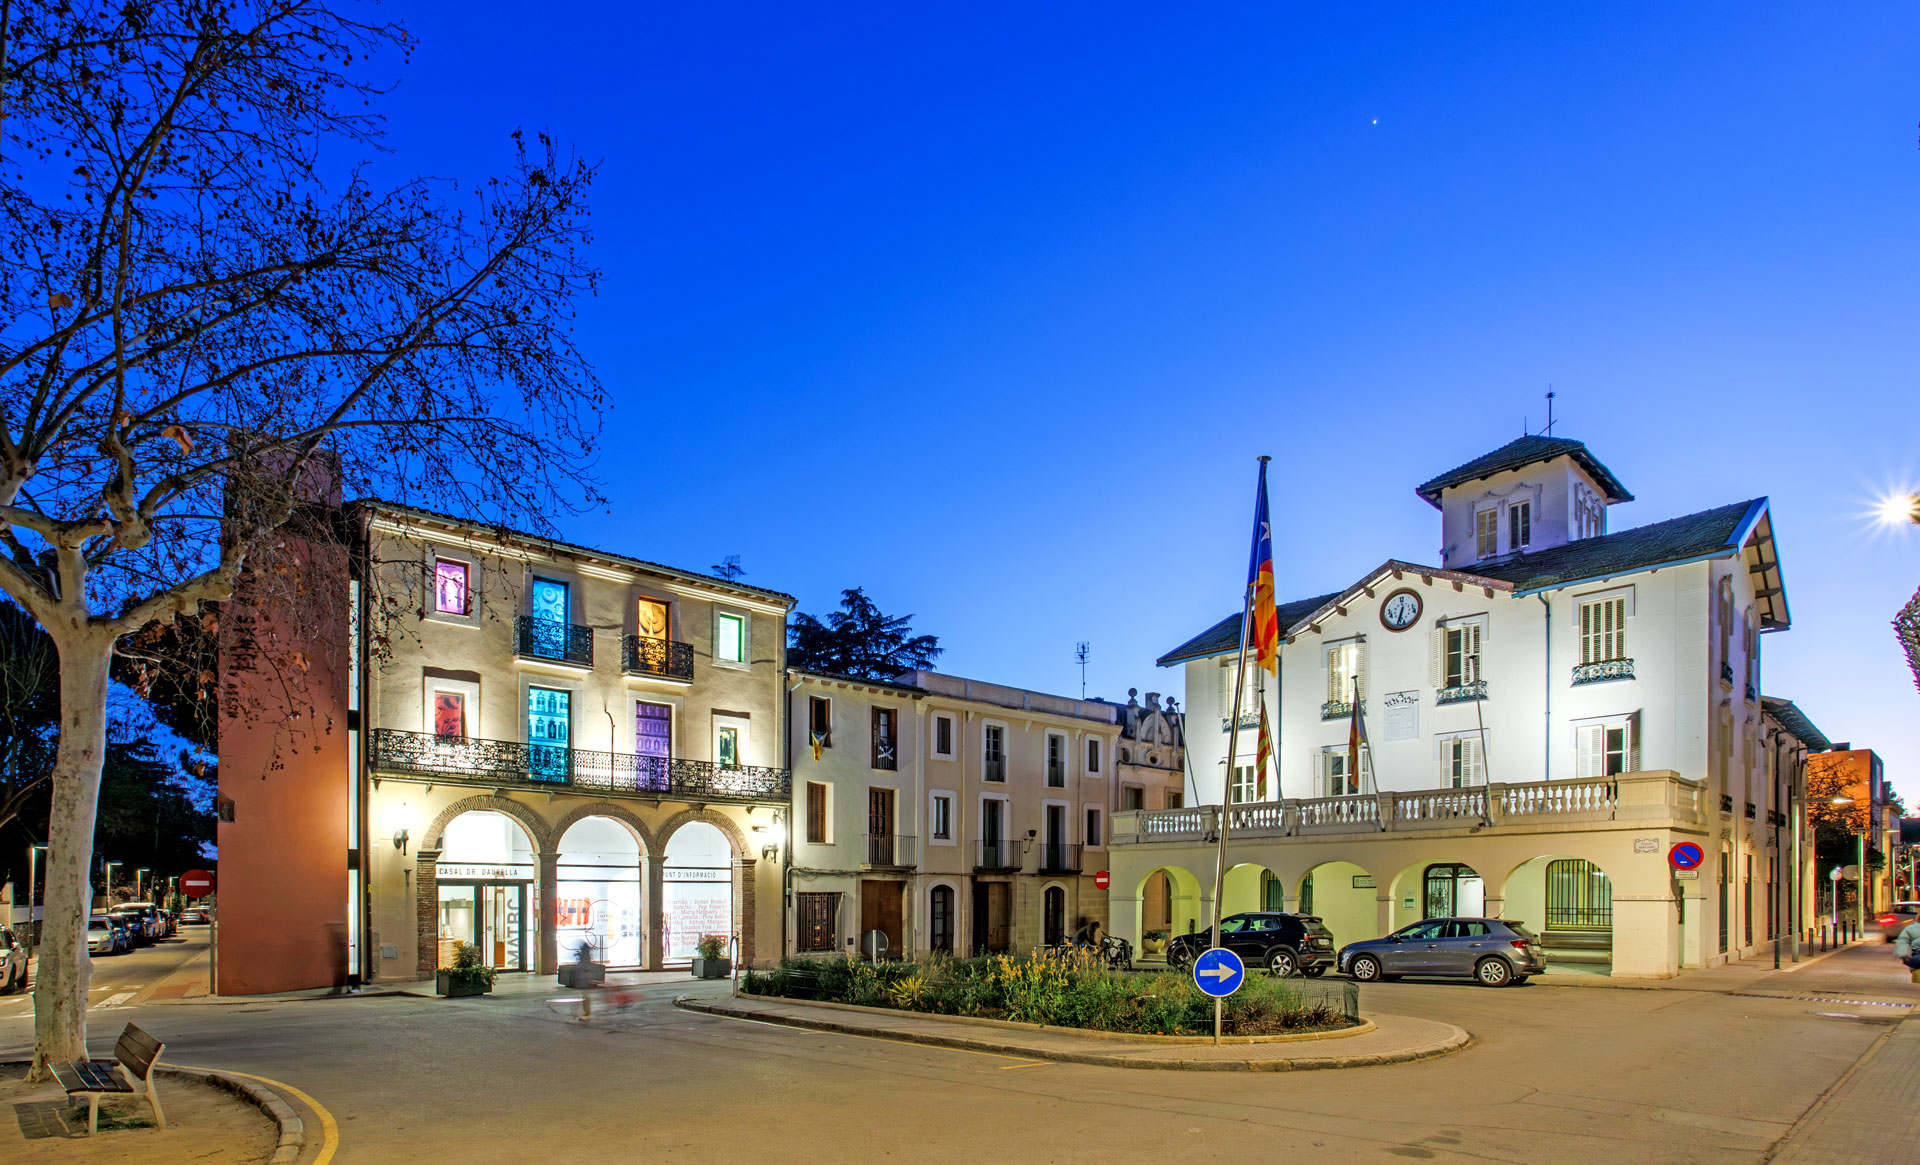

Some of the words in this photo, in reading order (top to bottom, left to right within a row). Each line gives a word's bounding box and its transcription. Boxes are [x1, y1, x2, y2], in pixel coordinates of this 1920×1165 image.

[439, 867, 463, 875] CASAL
[466, 868, 479, 876] DR.
[481, 868, 518, 876] DAURELLA
